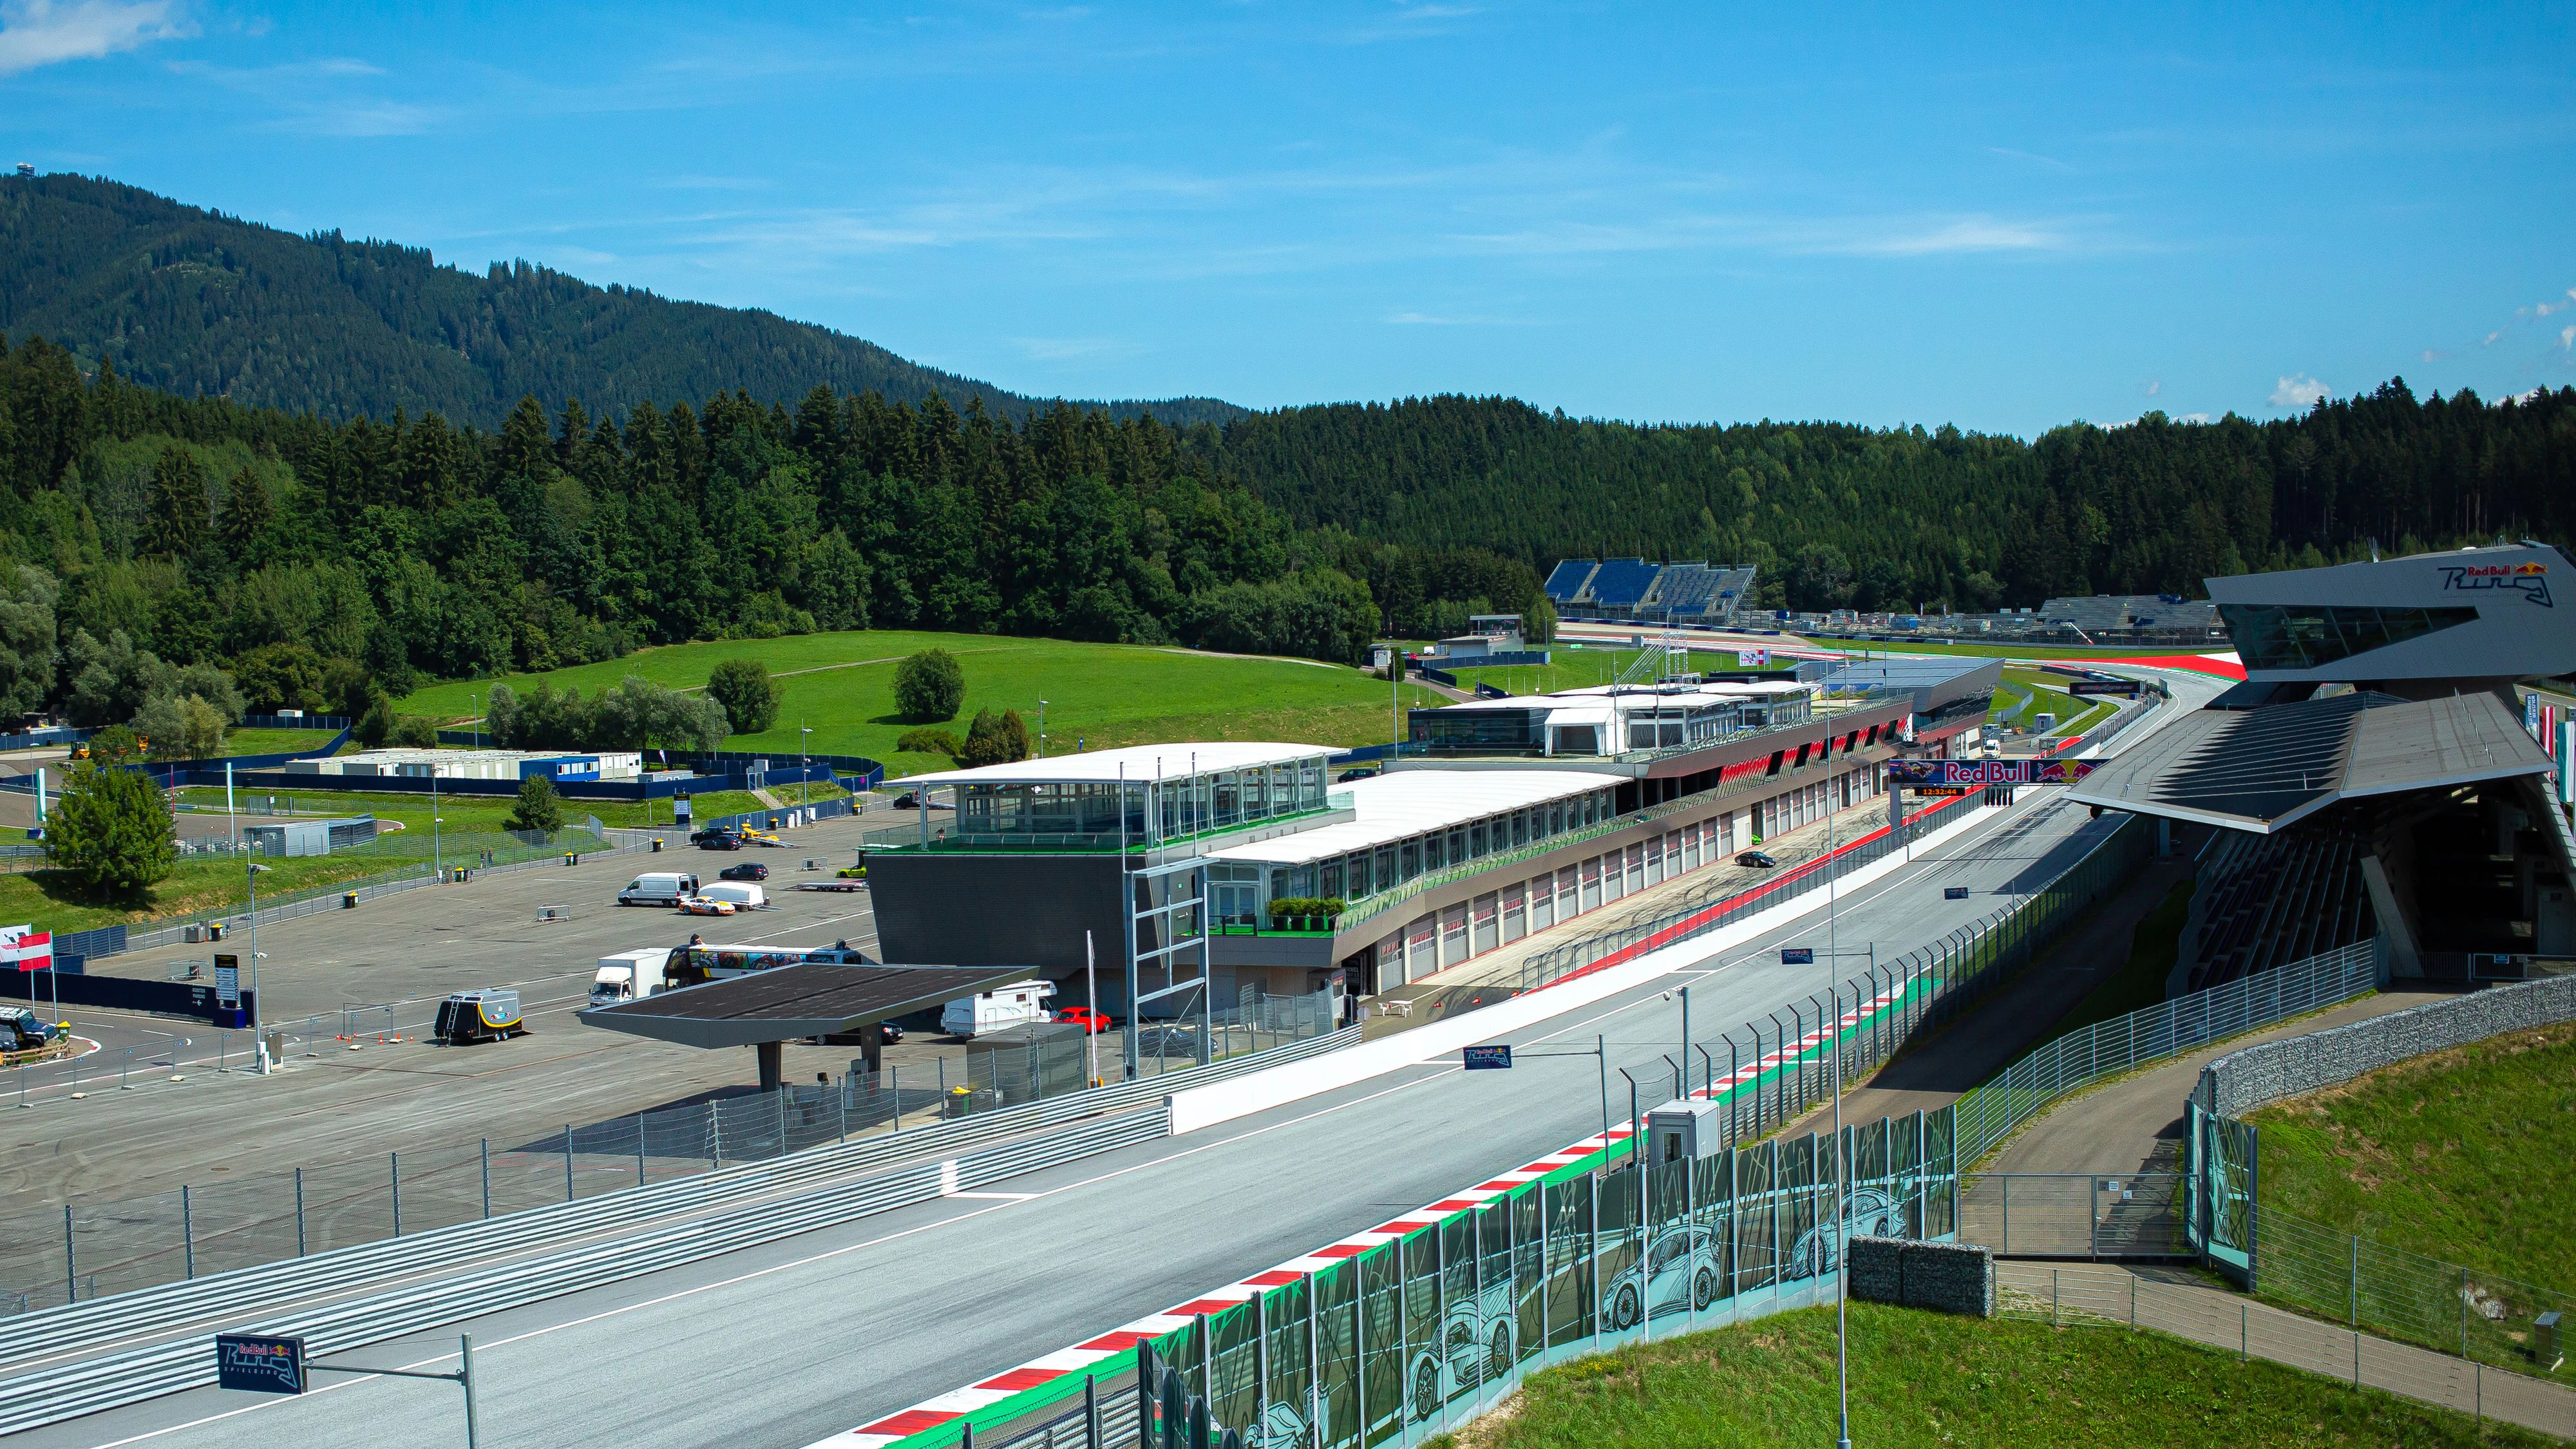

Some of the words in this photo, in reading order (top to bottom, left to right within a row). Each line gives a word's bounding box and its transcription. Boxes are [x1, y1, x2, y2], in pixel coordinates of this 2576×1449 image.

[2468, 565, 2488, 576] Red
[2490, 565, 2510, 576] Bull
[1945, 761, 1987, 782] Red
[1989, 761, 2030, 782] Bull
[239, 1343, 253, 1354] Red
[254, 1344, 268, 1355] Bull
